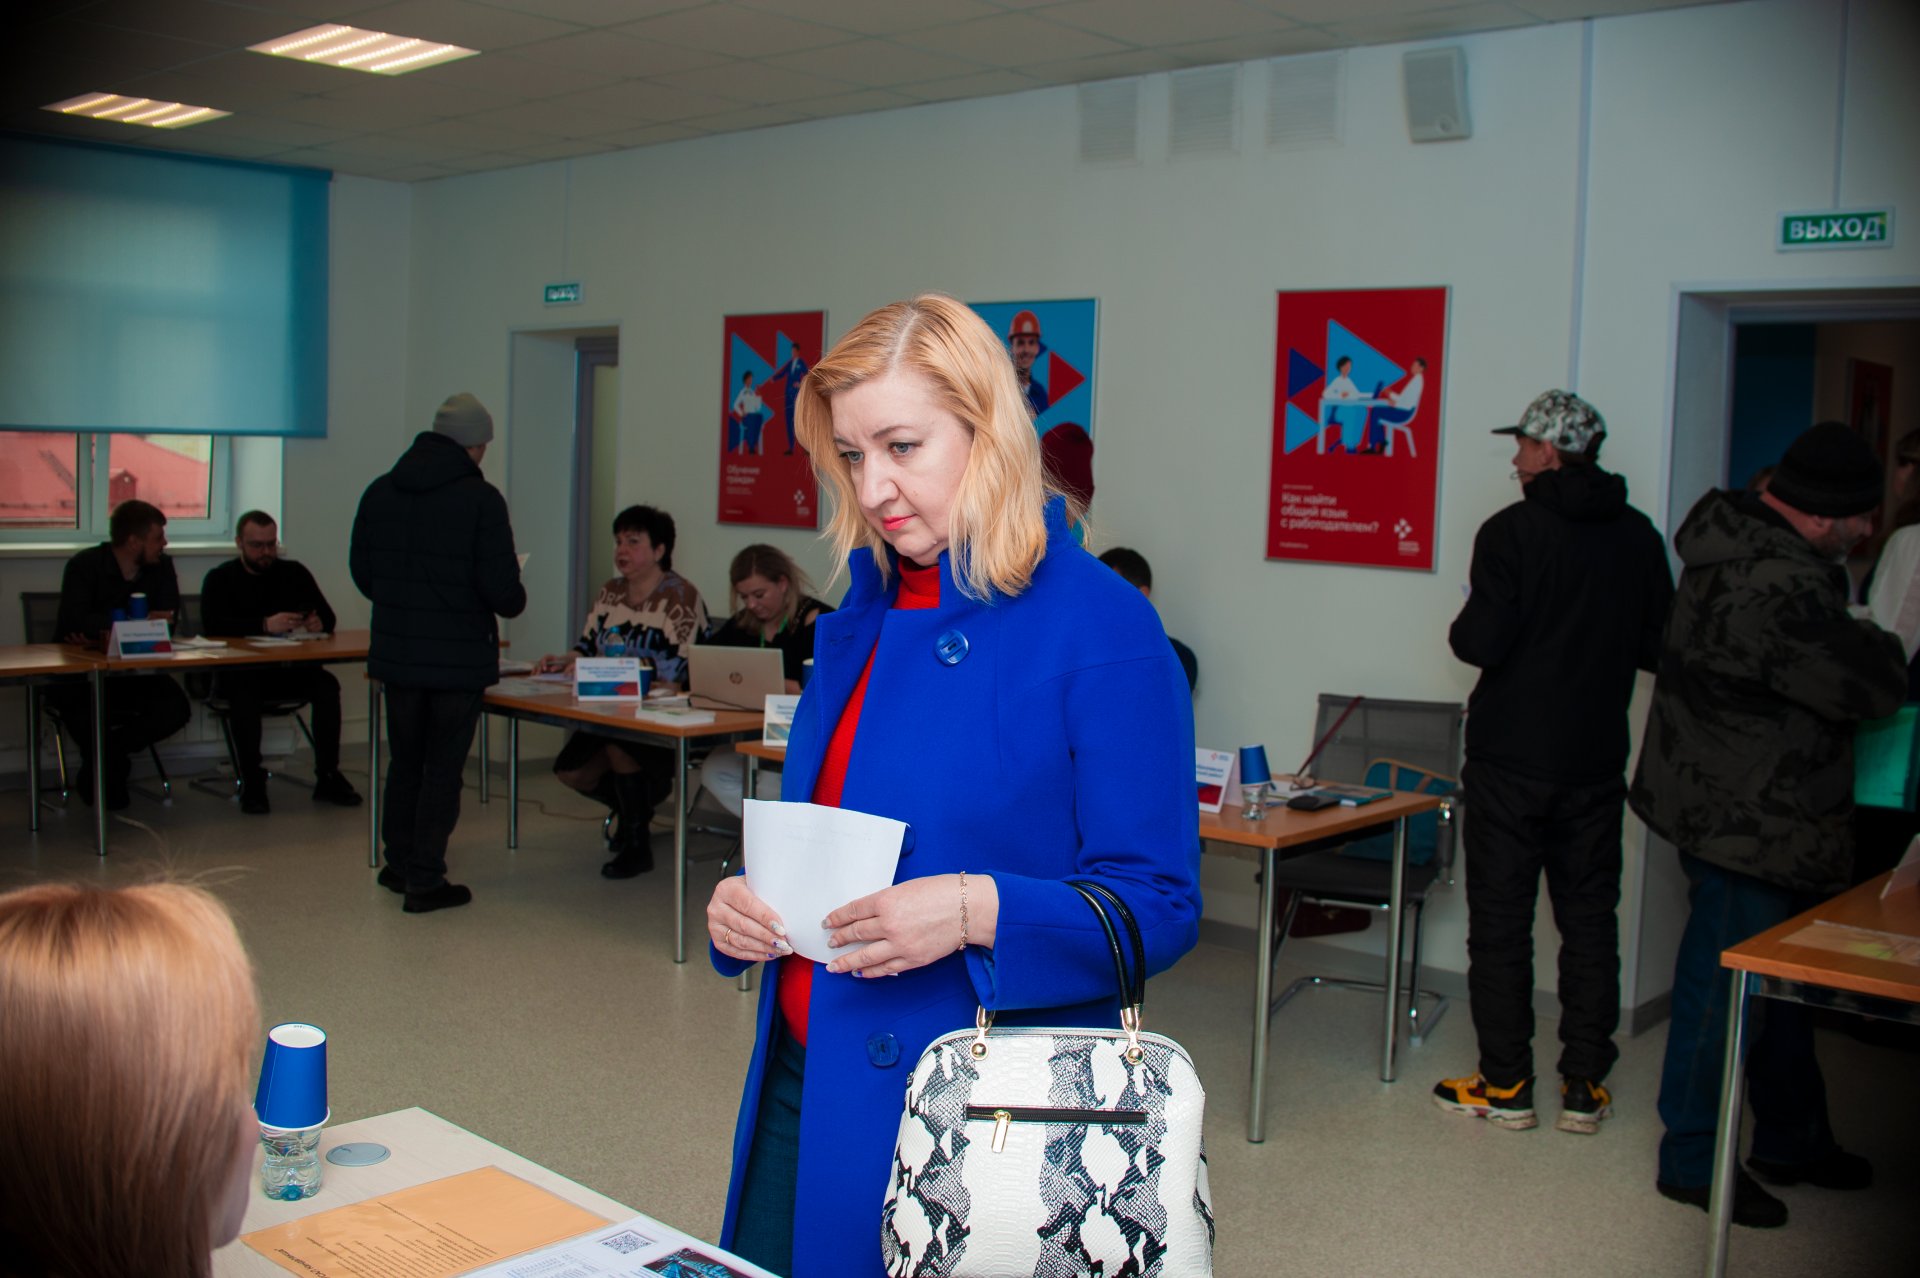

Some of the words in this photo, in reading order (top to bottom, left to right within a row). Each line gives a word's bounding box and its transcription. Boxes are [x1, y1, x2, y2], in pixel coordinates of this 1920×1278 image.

[1789, 216, 1881, 241] ВЫХОД
[1282, 492, 1301, 504] Как
[1303, 493, 1337, 505] найти
[1280, 505, 1318, 518] общий
[1321, 508, 1348, 519] язык
[1280, 519, 1288, 528] с
